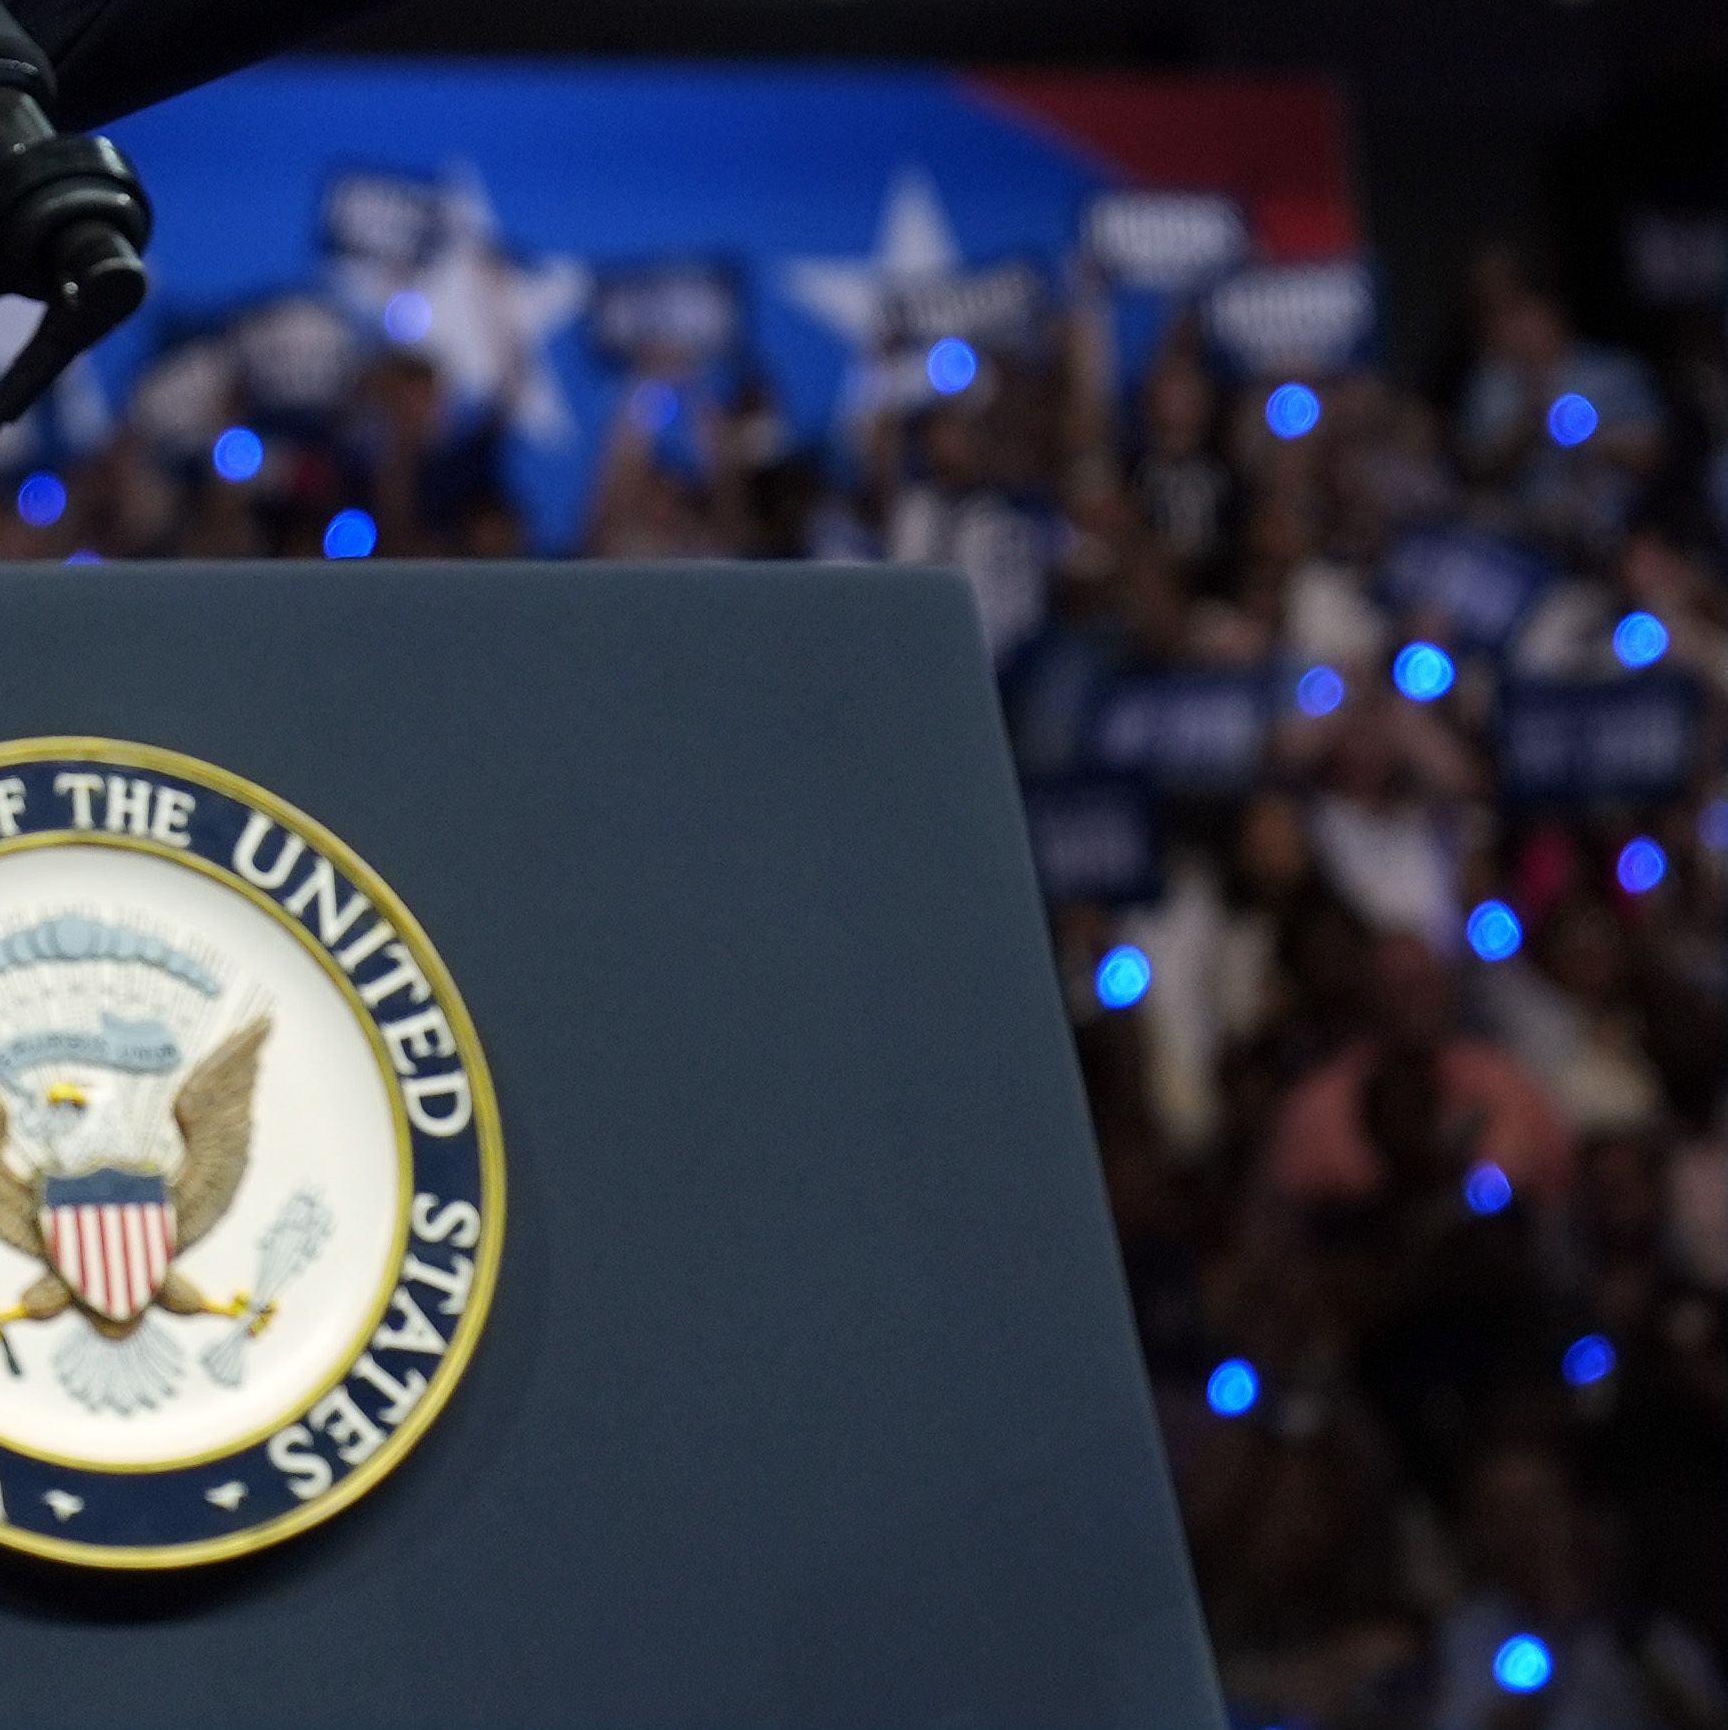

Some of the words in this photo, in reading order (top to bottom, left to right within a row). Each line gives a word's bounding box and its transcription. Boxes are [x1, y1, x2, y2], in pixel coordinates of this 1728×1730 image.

[55, 772, 196, 848] THE
[234, 812, 473, 1137] UNITED
[267, 1193, 481, 1500] STATES
